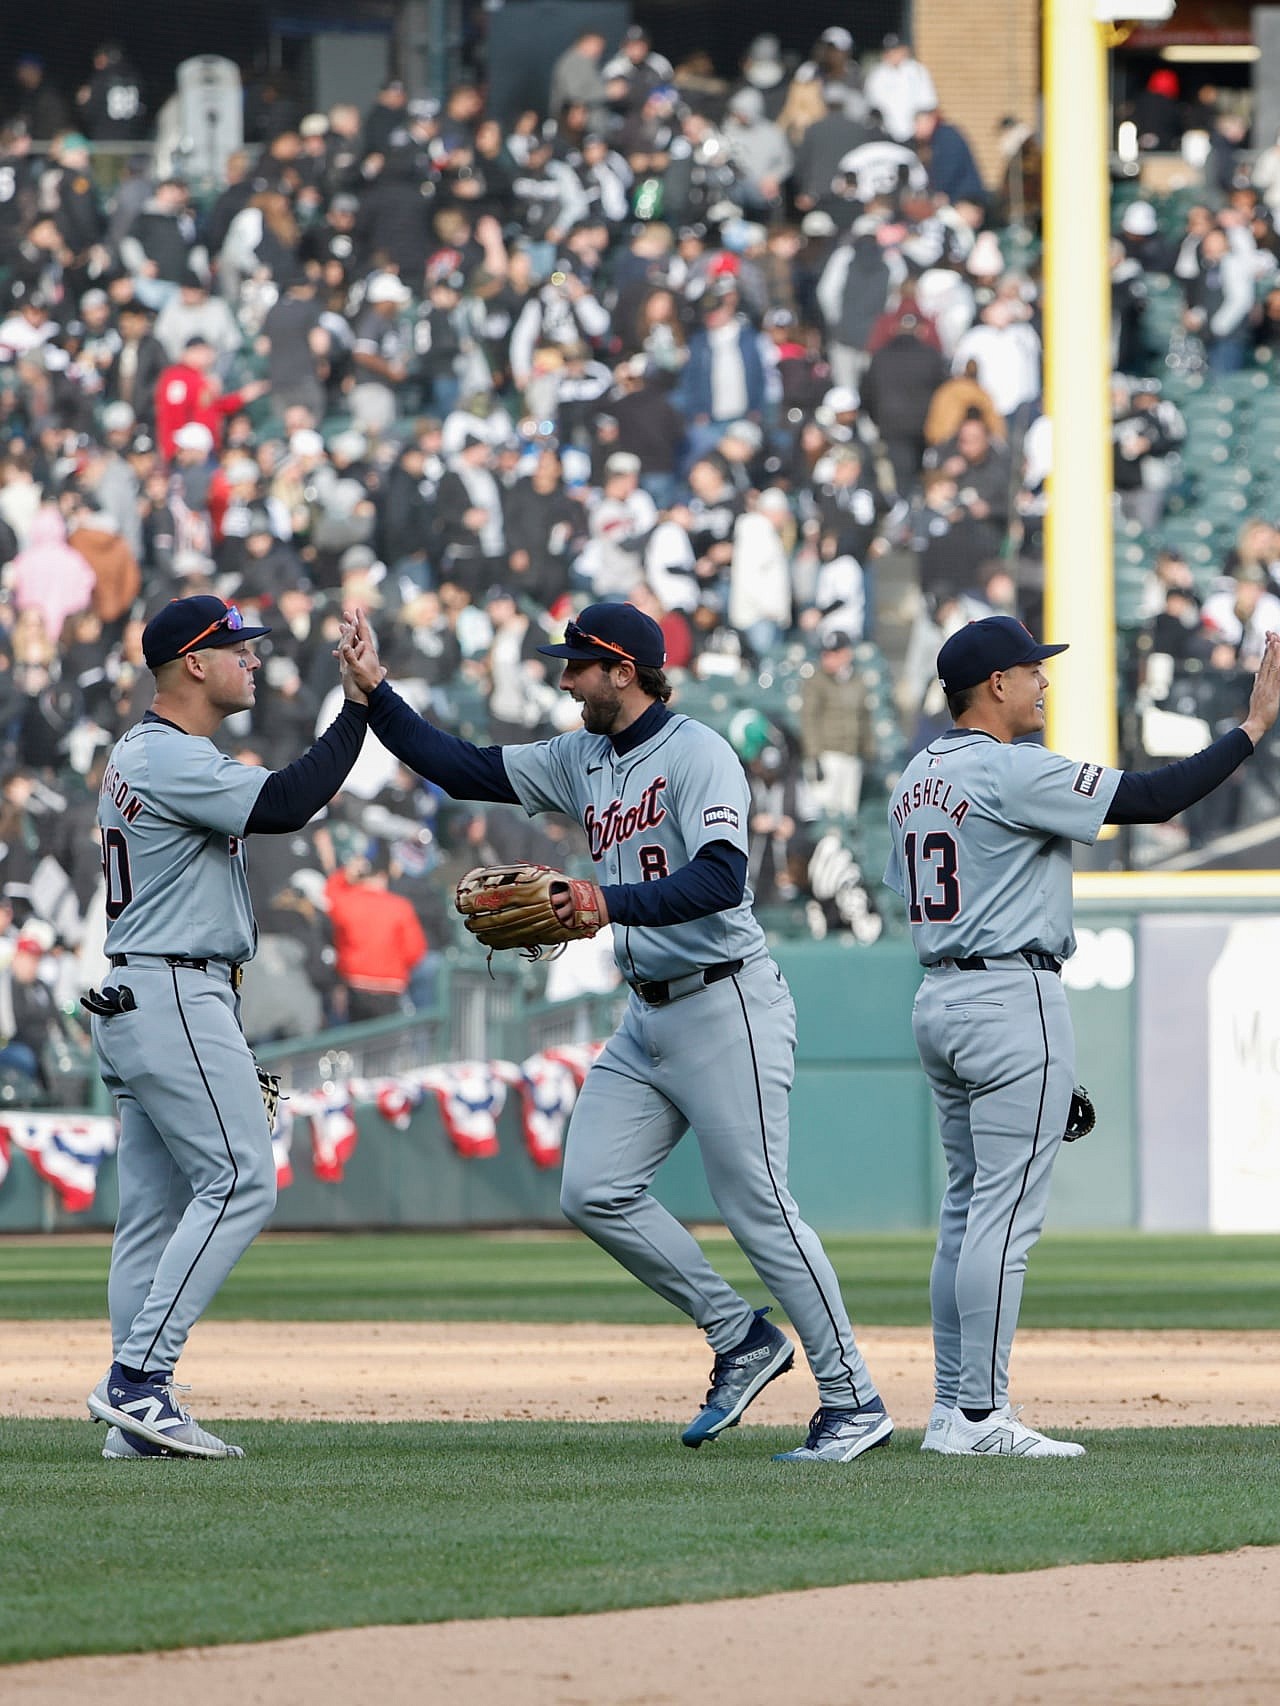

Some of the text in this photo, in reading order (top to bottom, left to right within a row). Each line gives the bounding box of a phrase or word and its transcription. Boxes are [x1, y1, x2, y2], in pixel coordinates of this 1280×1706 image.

[892, 777, 970, 829] URSHELA
[638, 844, 671, 882] 8
[904, 831, 961, 924] 13
